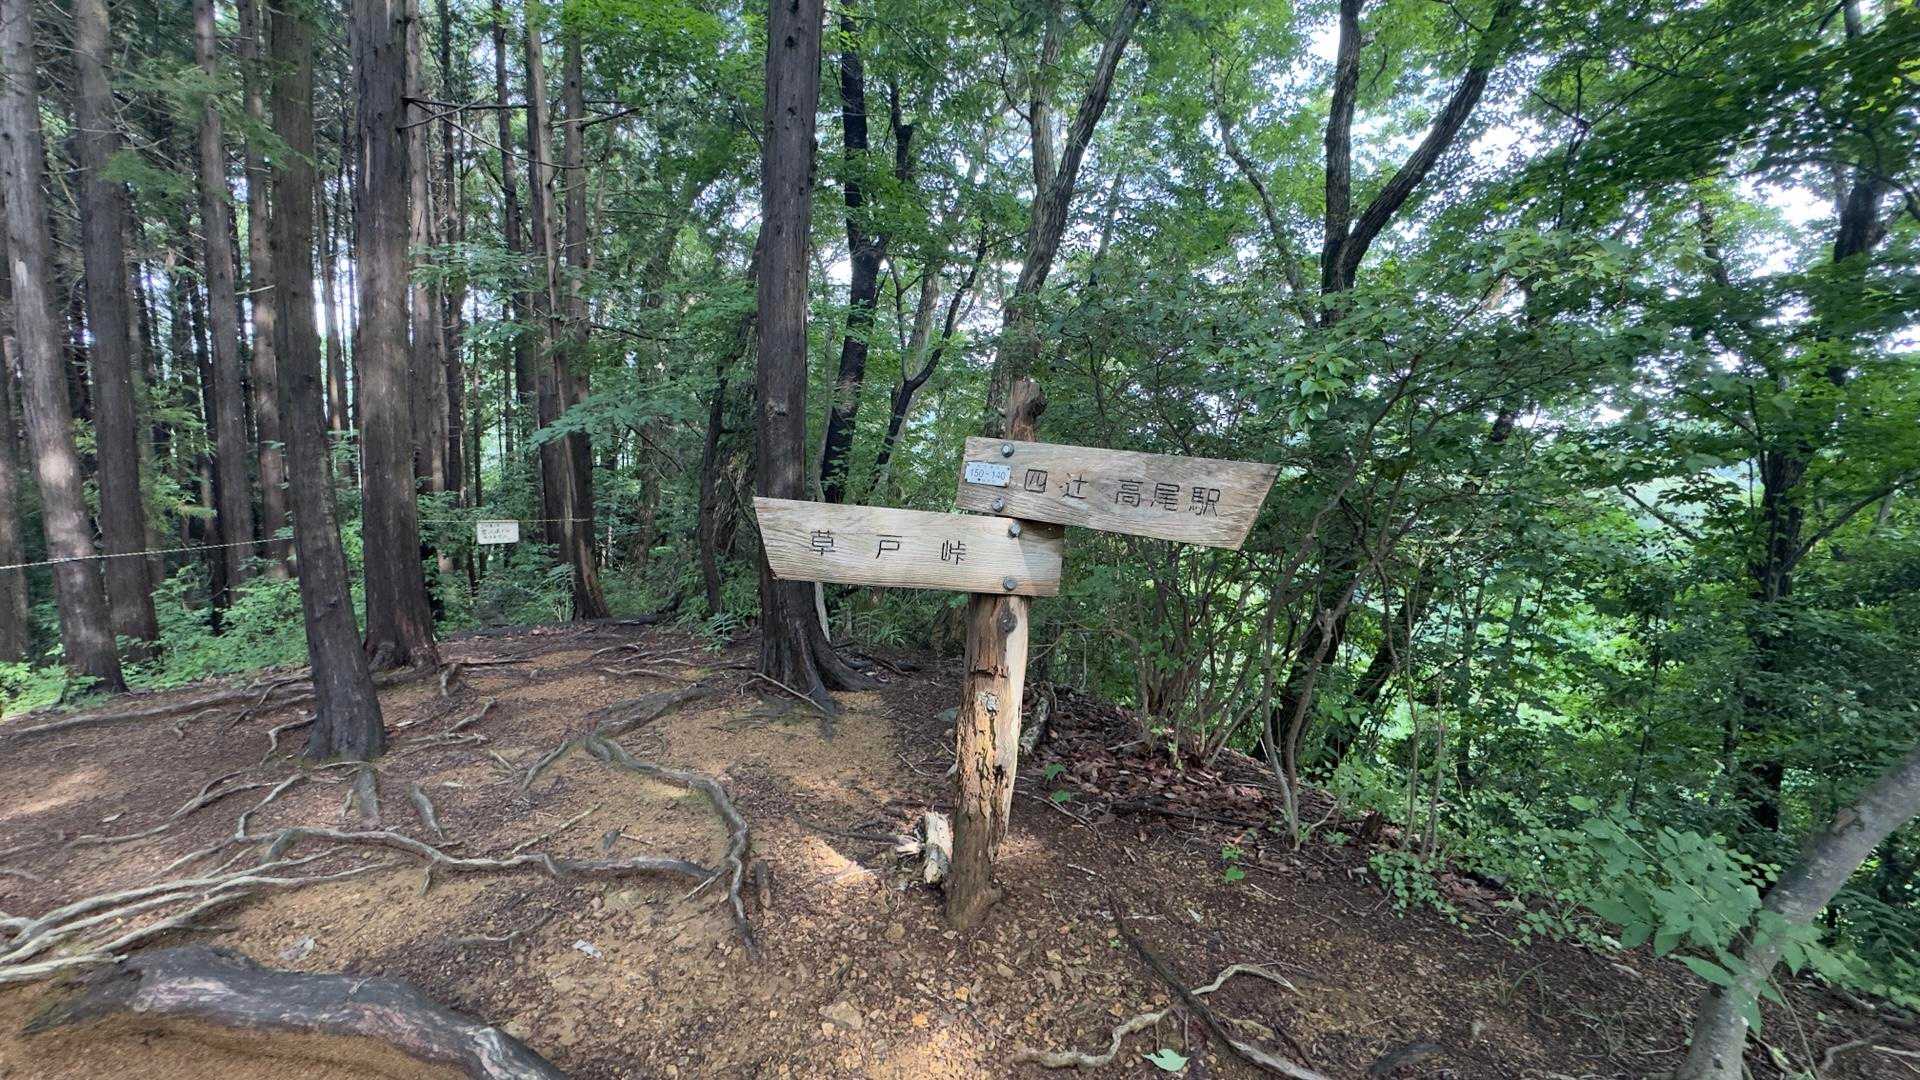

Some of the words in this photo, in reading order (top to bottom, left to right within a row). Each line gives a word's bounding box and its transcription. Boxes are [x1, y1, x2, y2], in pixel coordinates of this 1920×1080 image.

[1114, 479, 1221, 517] 高尾駅
[809, 529, 967, 565] 草戸峠
